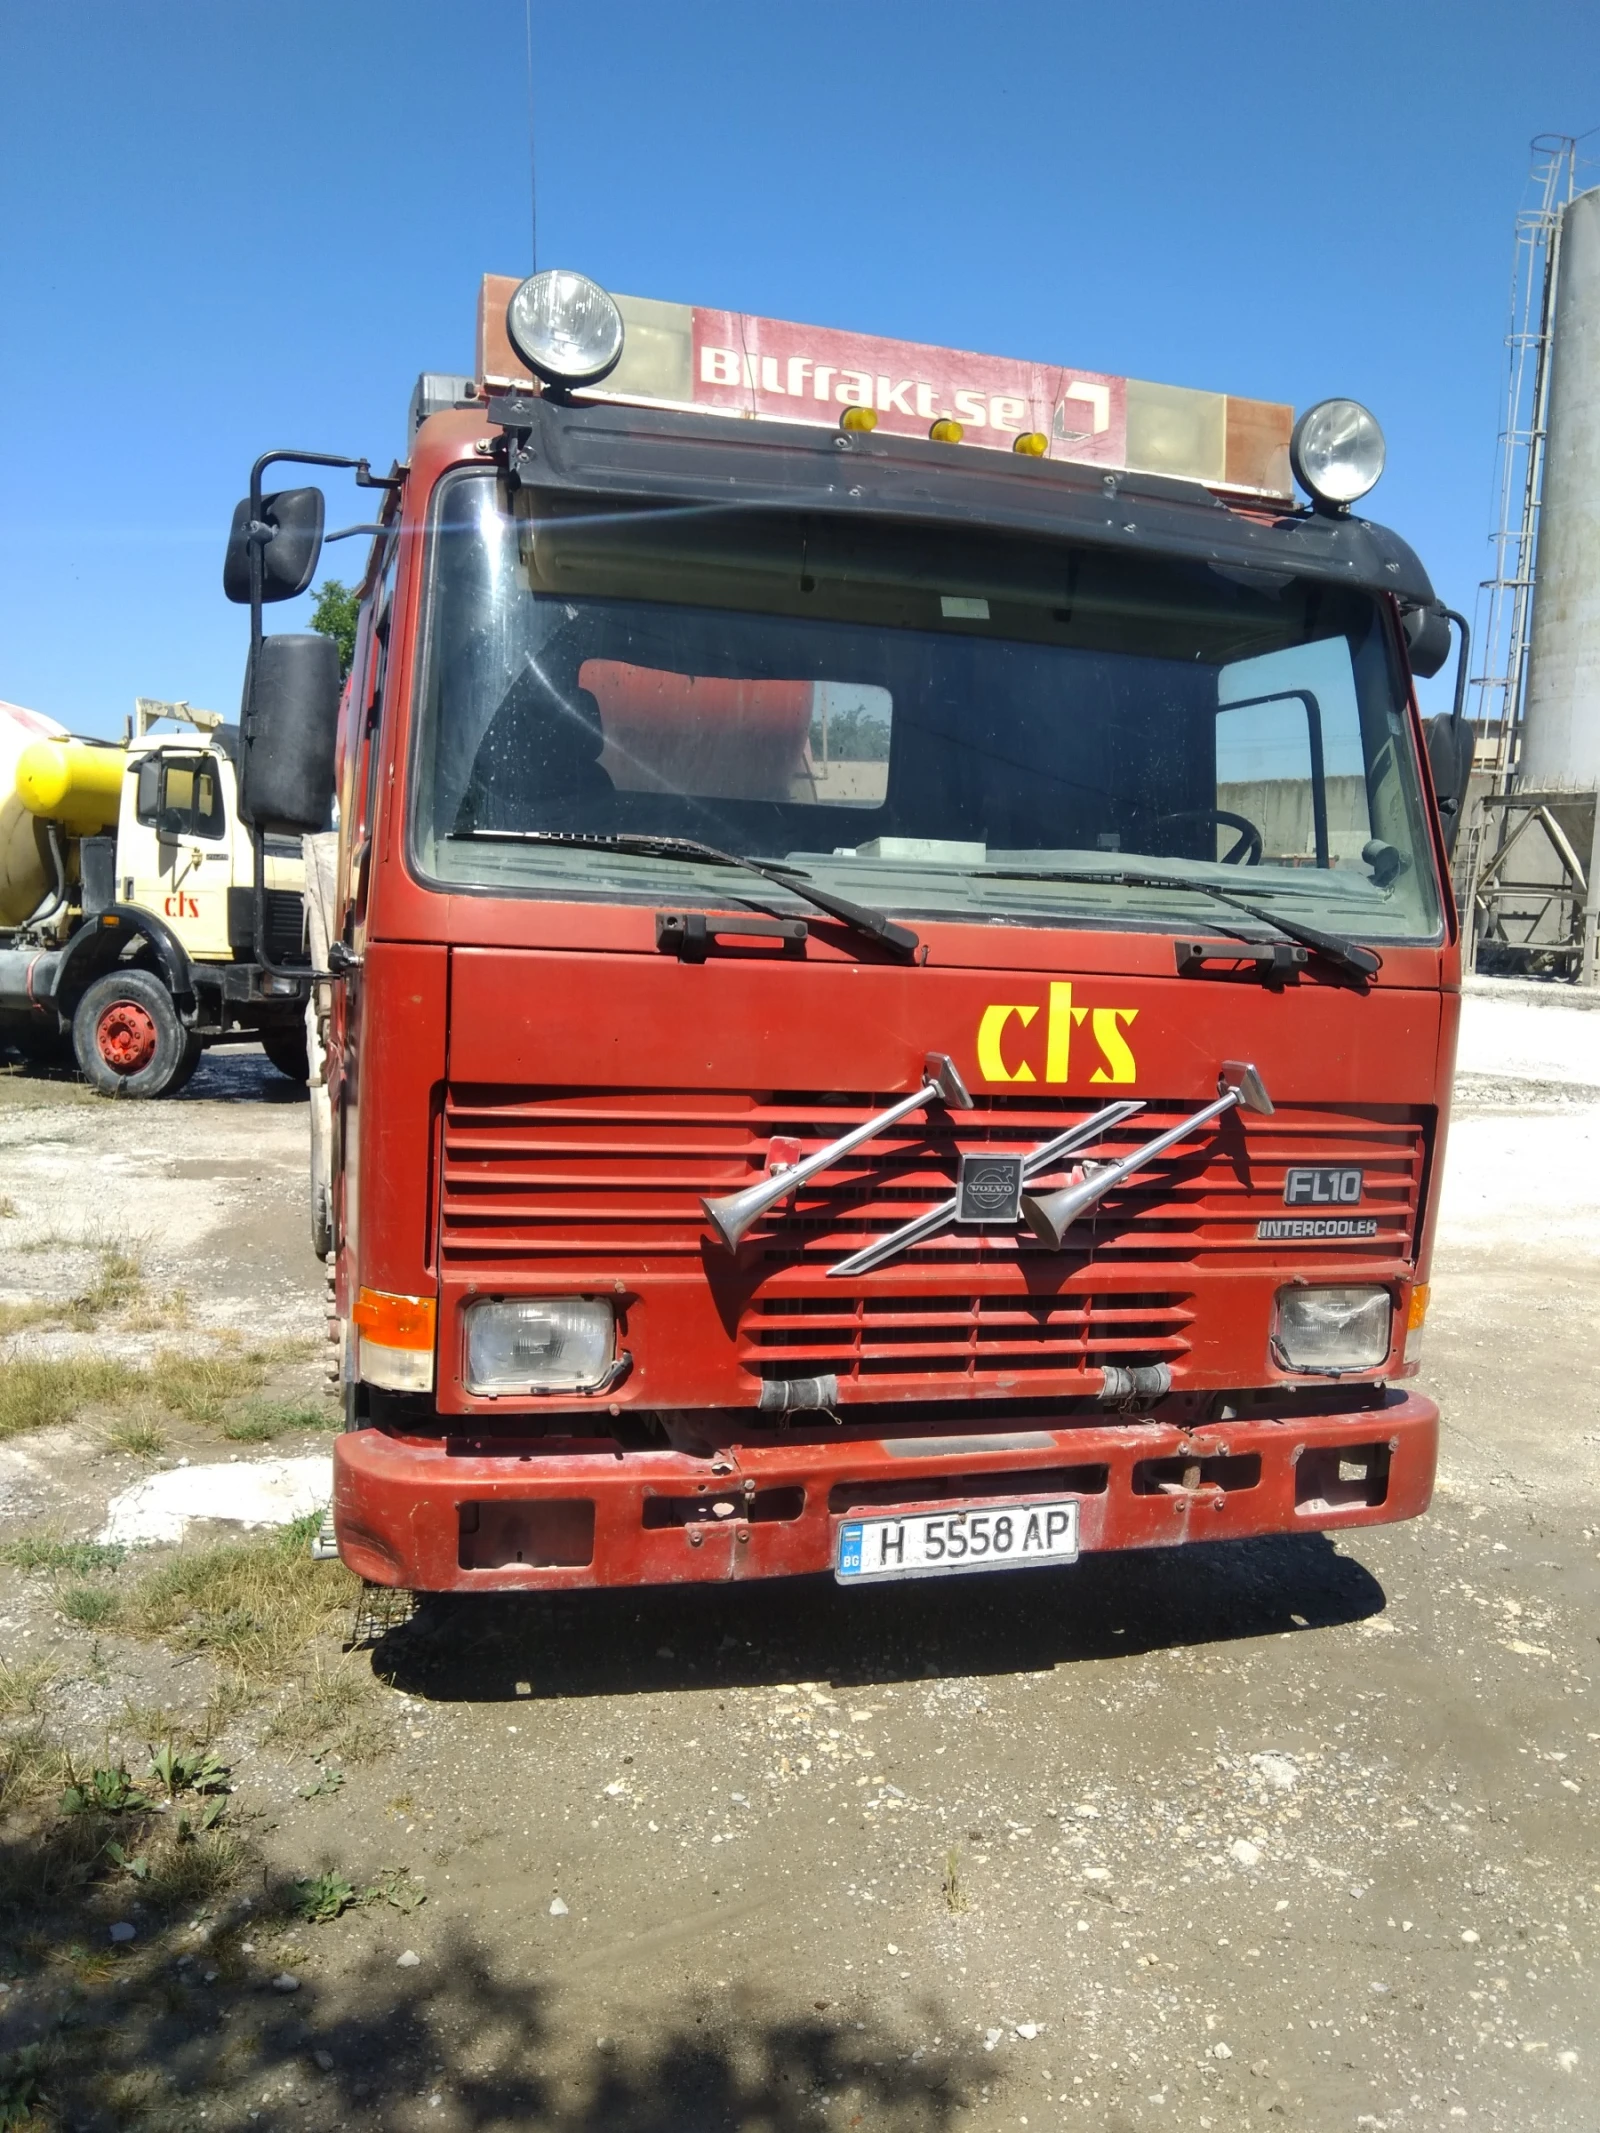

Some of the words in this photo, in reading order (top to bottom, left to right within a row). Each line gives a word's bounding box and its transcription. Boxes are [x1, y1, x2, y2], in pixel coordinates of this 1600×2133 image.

[977, 981, 1139, 1083] cts
[1289, 1171, 1361, 1201] FL10
[1260, 1220, 1377, 1237] INTERCOOLER
[880, 1525, 905, 1565] H
[924, 1516, 1014, 1560] 5558
[1022, 1510, 1070, 1552] AP
[843, 1555, 860, 1568] BG
